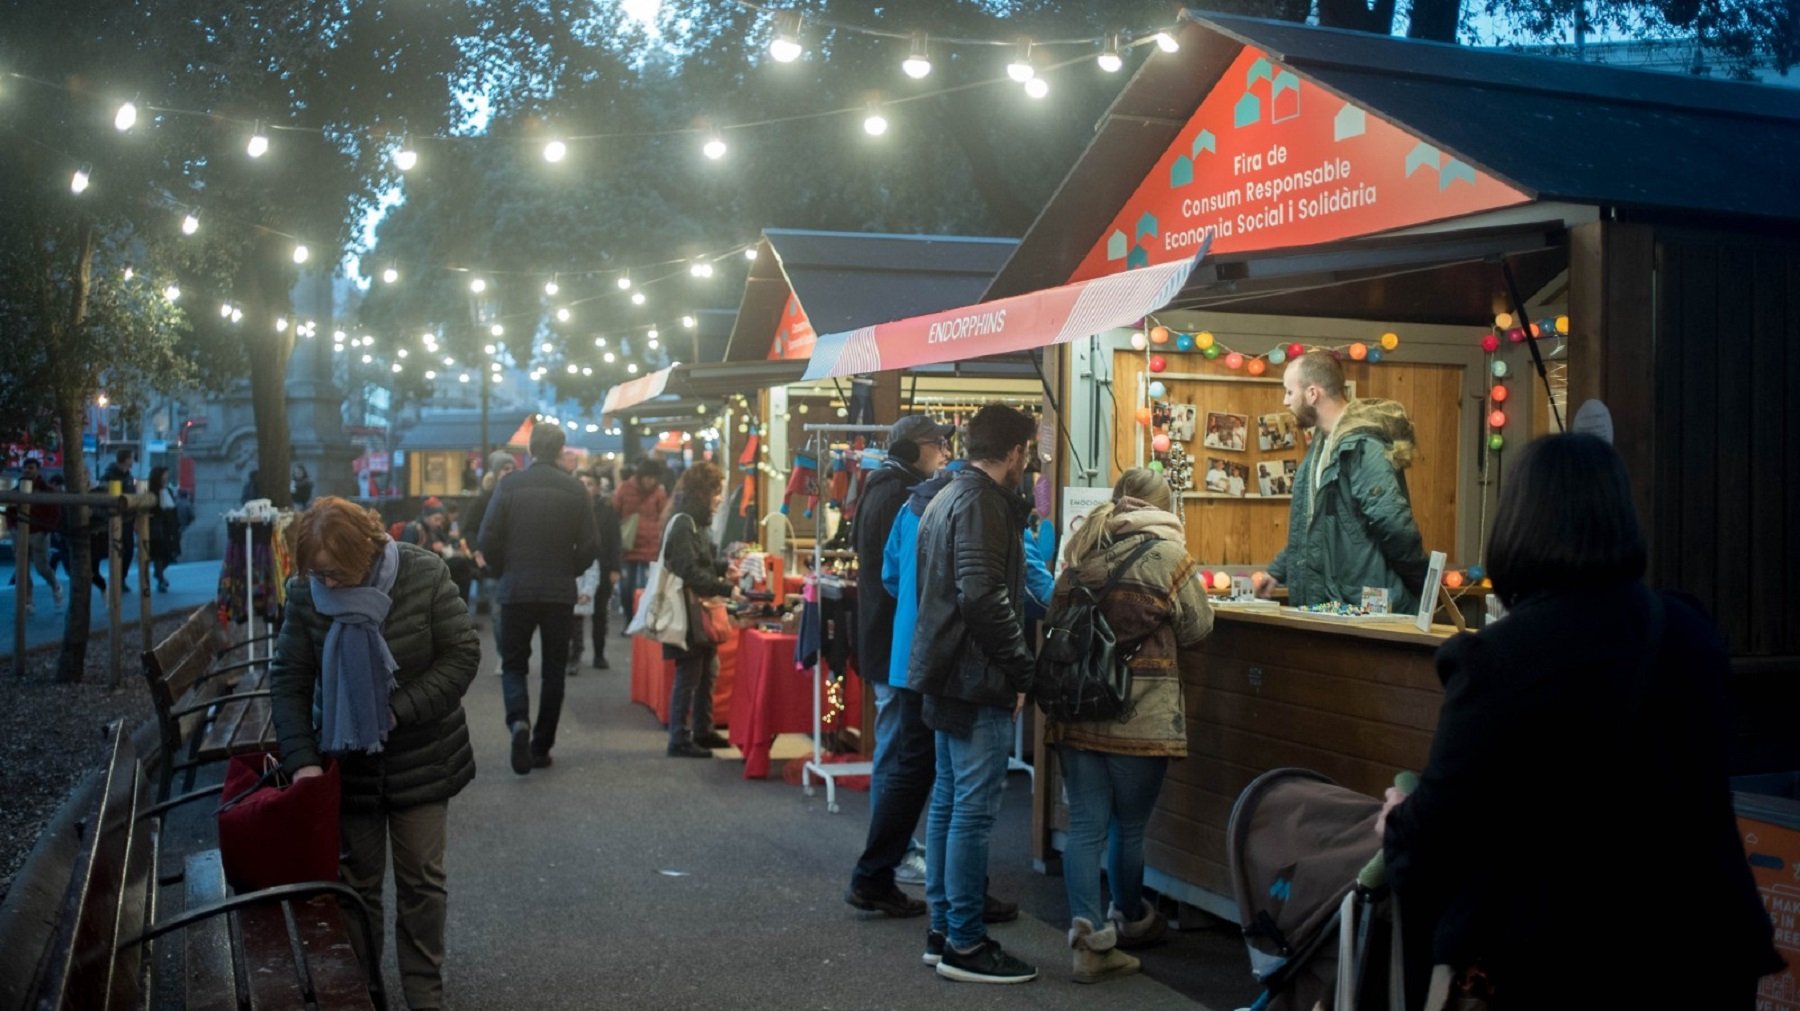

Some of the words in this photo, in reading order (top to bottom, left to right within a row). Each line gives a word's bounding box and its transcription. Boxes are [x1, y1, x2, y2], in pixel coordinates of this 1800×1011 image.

[1234, 152, 1262, 176] Fira
[1267, 144, 1287, 167] de
[1182, 189, 1241, 218] Consum
[1246, 157, 1351, 203] Responsable
[1165, 217, 1232, 251] Economia
[1237, 201, 1284, 234] Social
[1288, 200, 1294, 223] i
[1298, 182, 1377, 219] Solidària
[927, 309, 1007, 344] ENDORPHINS
